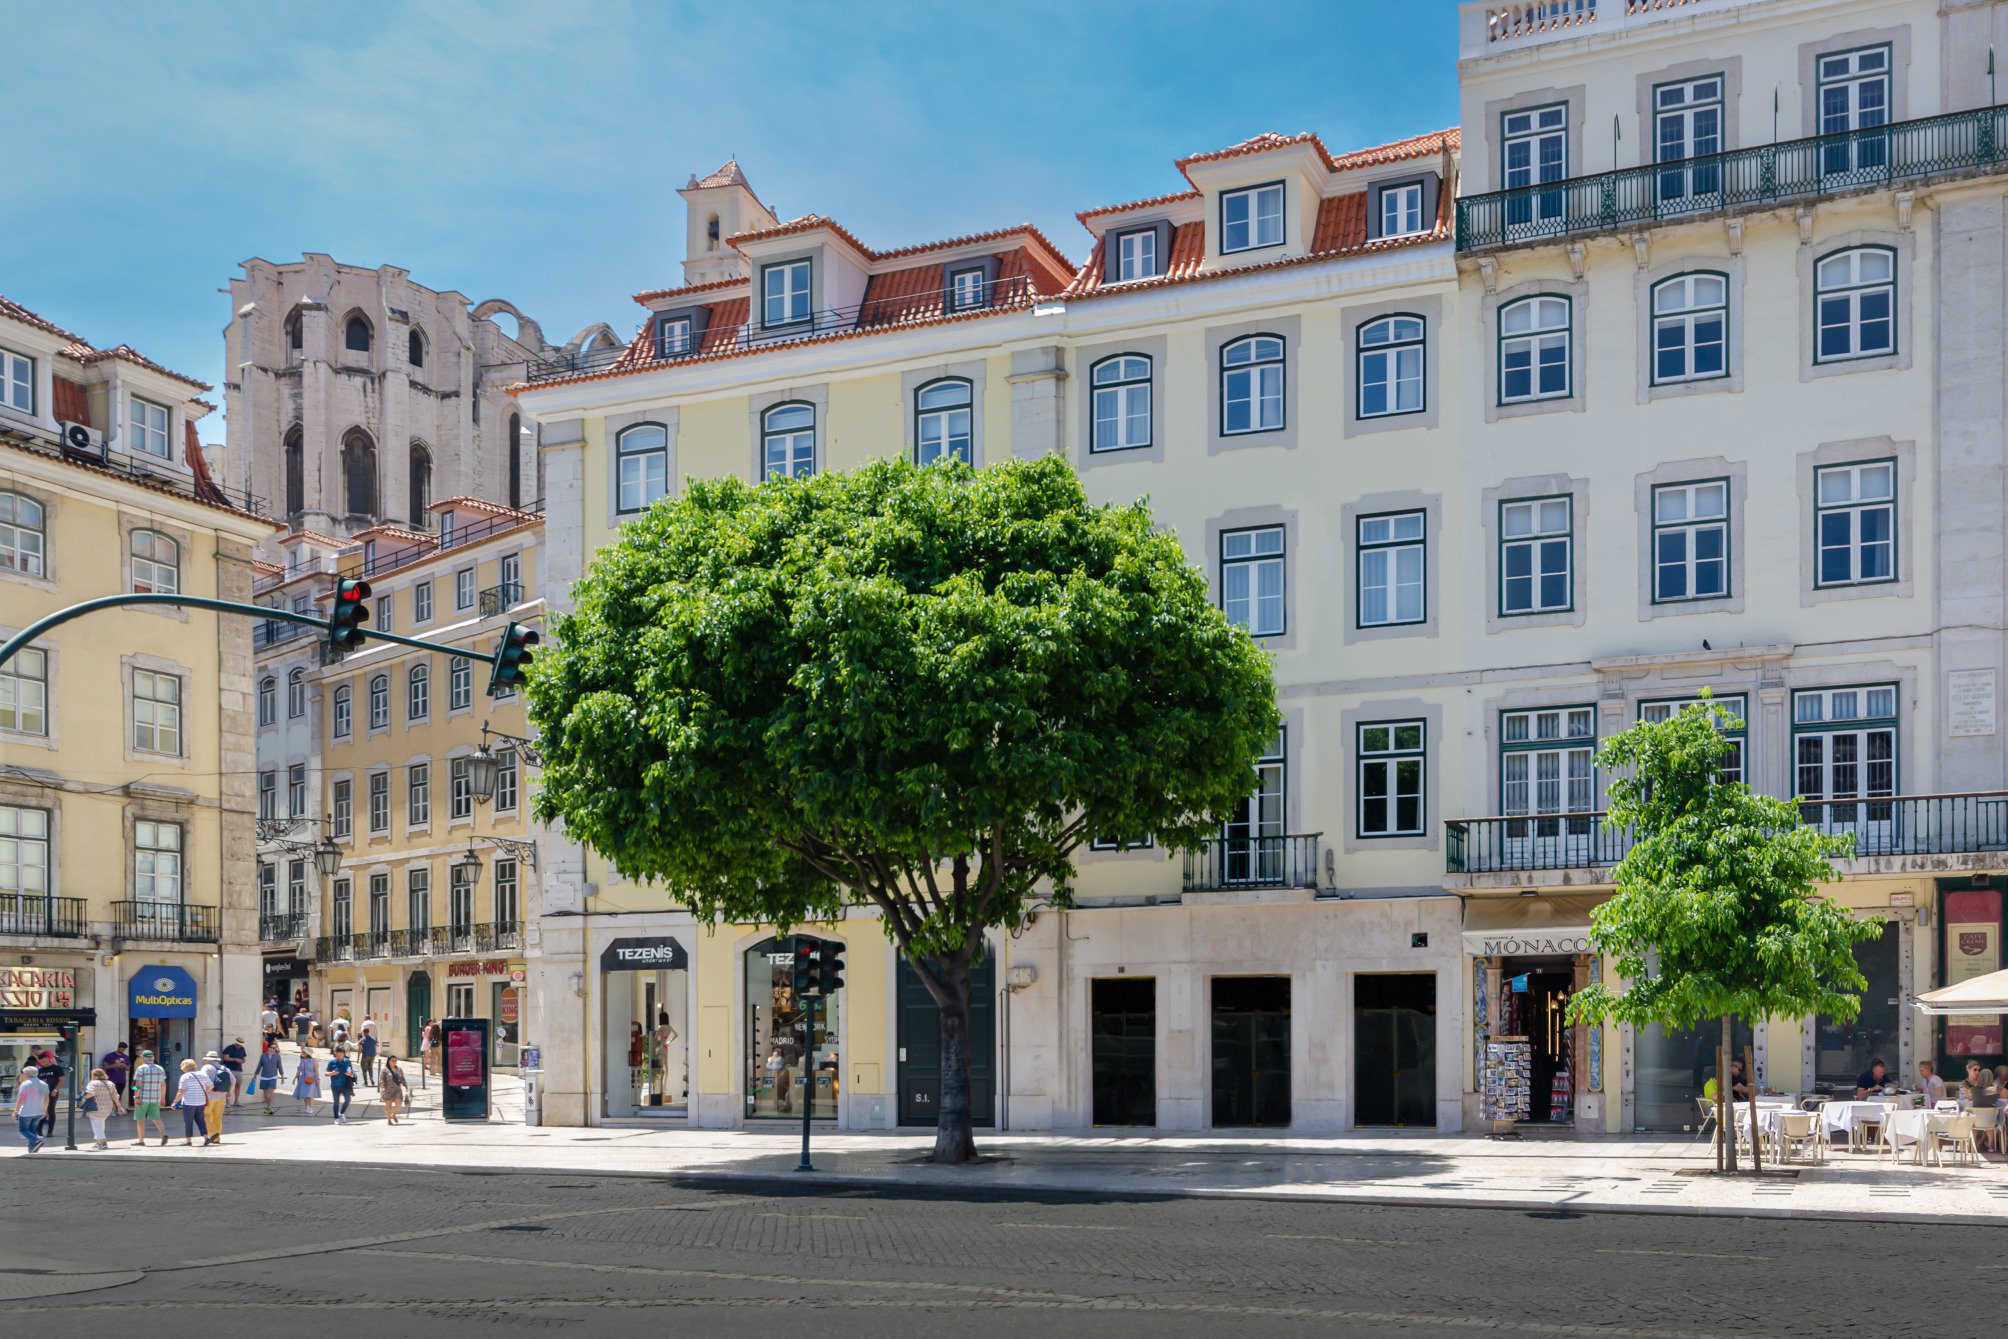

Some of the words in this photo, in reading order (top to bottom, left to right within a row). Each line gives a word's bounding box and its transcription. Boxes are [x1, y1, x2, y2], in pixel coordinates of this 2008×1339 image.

[1484, 936, 1590, 955] MÓNACO
[448, 963, 480, 977] BURGER
[483, 961, 504, 975] KING
[136, 995, 193, 1006] MultiOpticas
